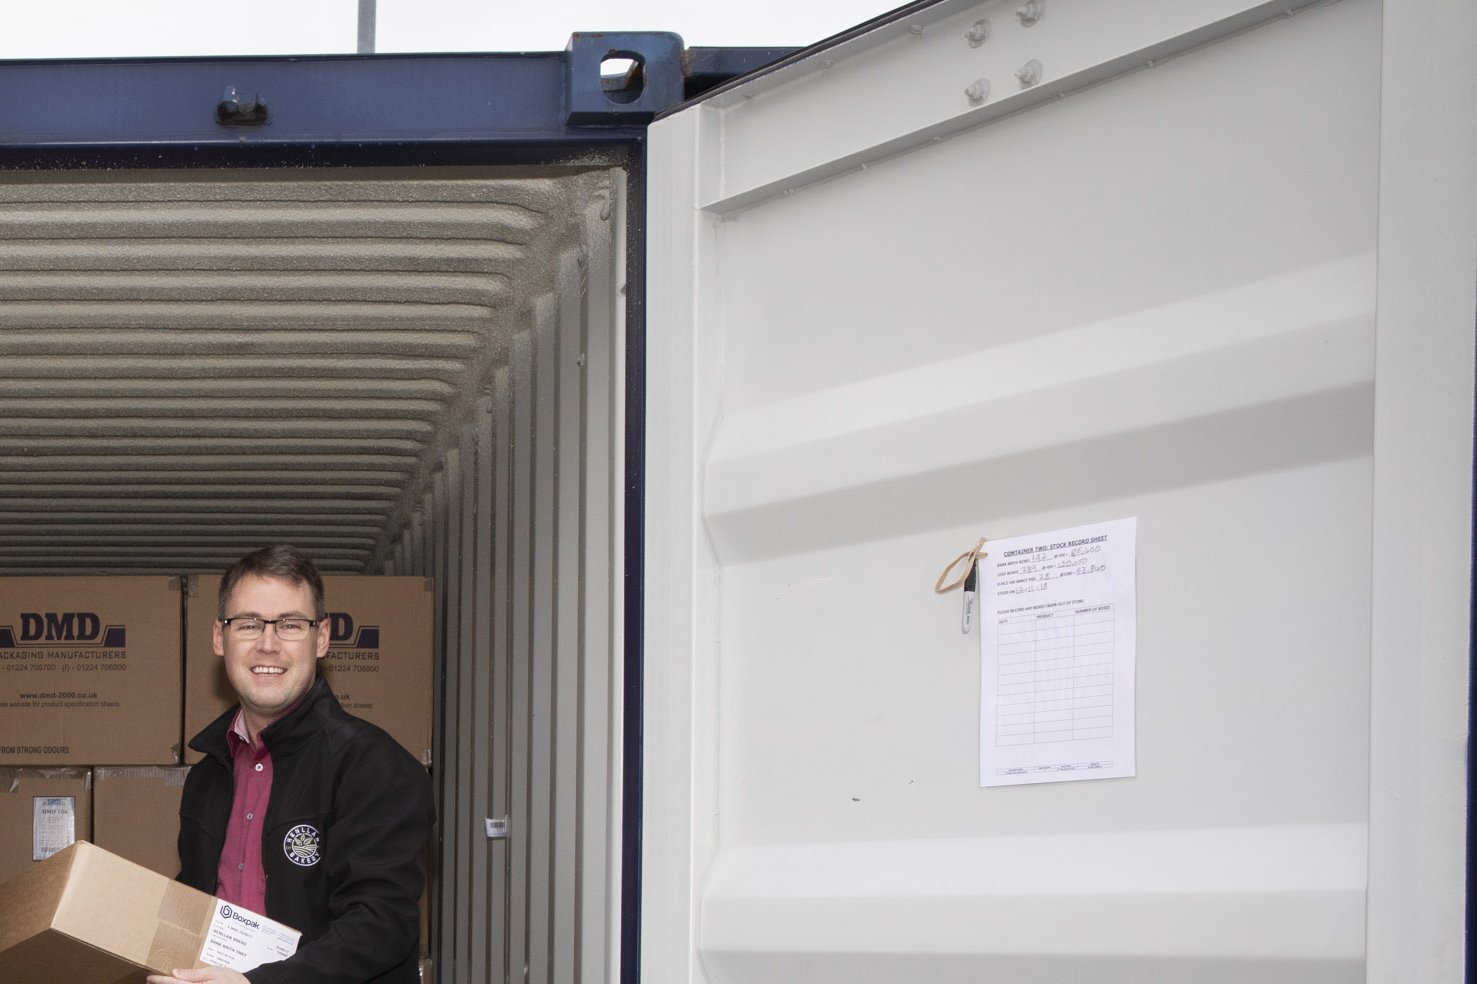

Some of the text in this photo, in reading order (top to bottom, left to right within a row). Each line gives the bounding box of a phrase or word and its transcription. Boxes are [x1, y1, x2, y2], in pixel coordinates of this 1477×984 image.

[1004, 547, 1034, 557] CONTAINER
[1049, 542, 1067, 550] STOCK
[1068, 539, 1090, 547] RECORD
[1090, 535, 1108, 543] SHEET
[20, 612, 101, 641] DMD
[47, 651, 126, 659] MANUFACTURERS
[324, 652, 380, 660] FACTURERS
[16, 746, 42, 754] STRONG
[44, 746, 70, 754] ODOURS
[232, 911, 260, 930] Boxpak
